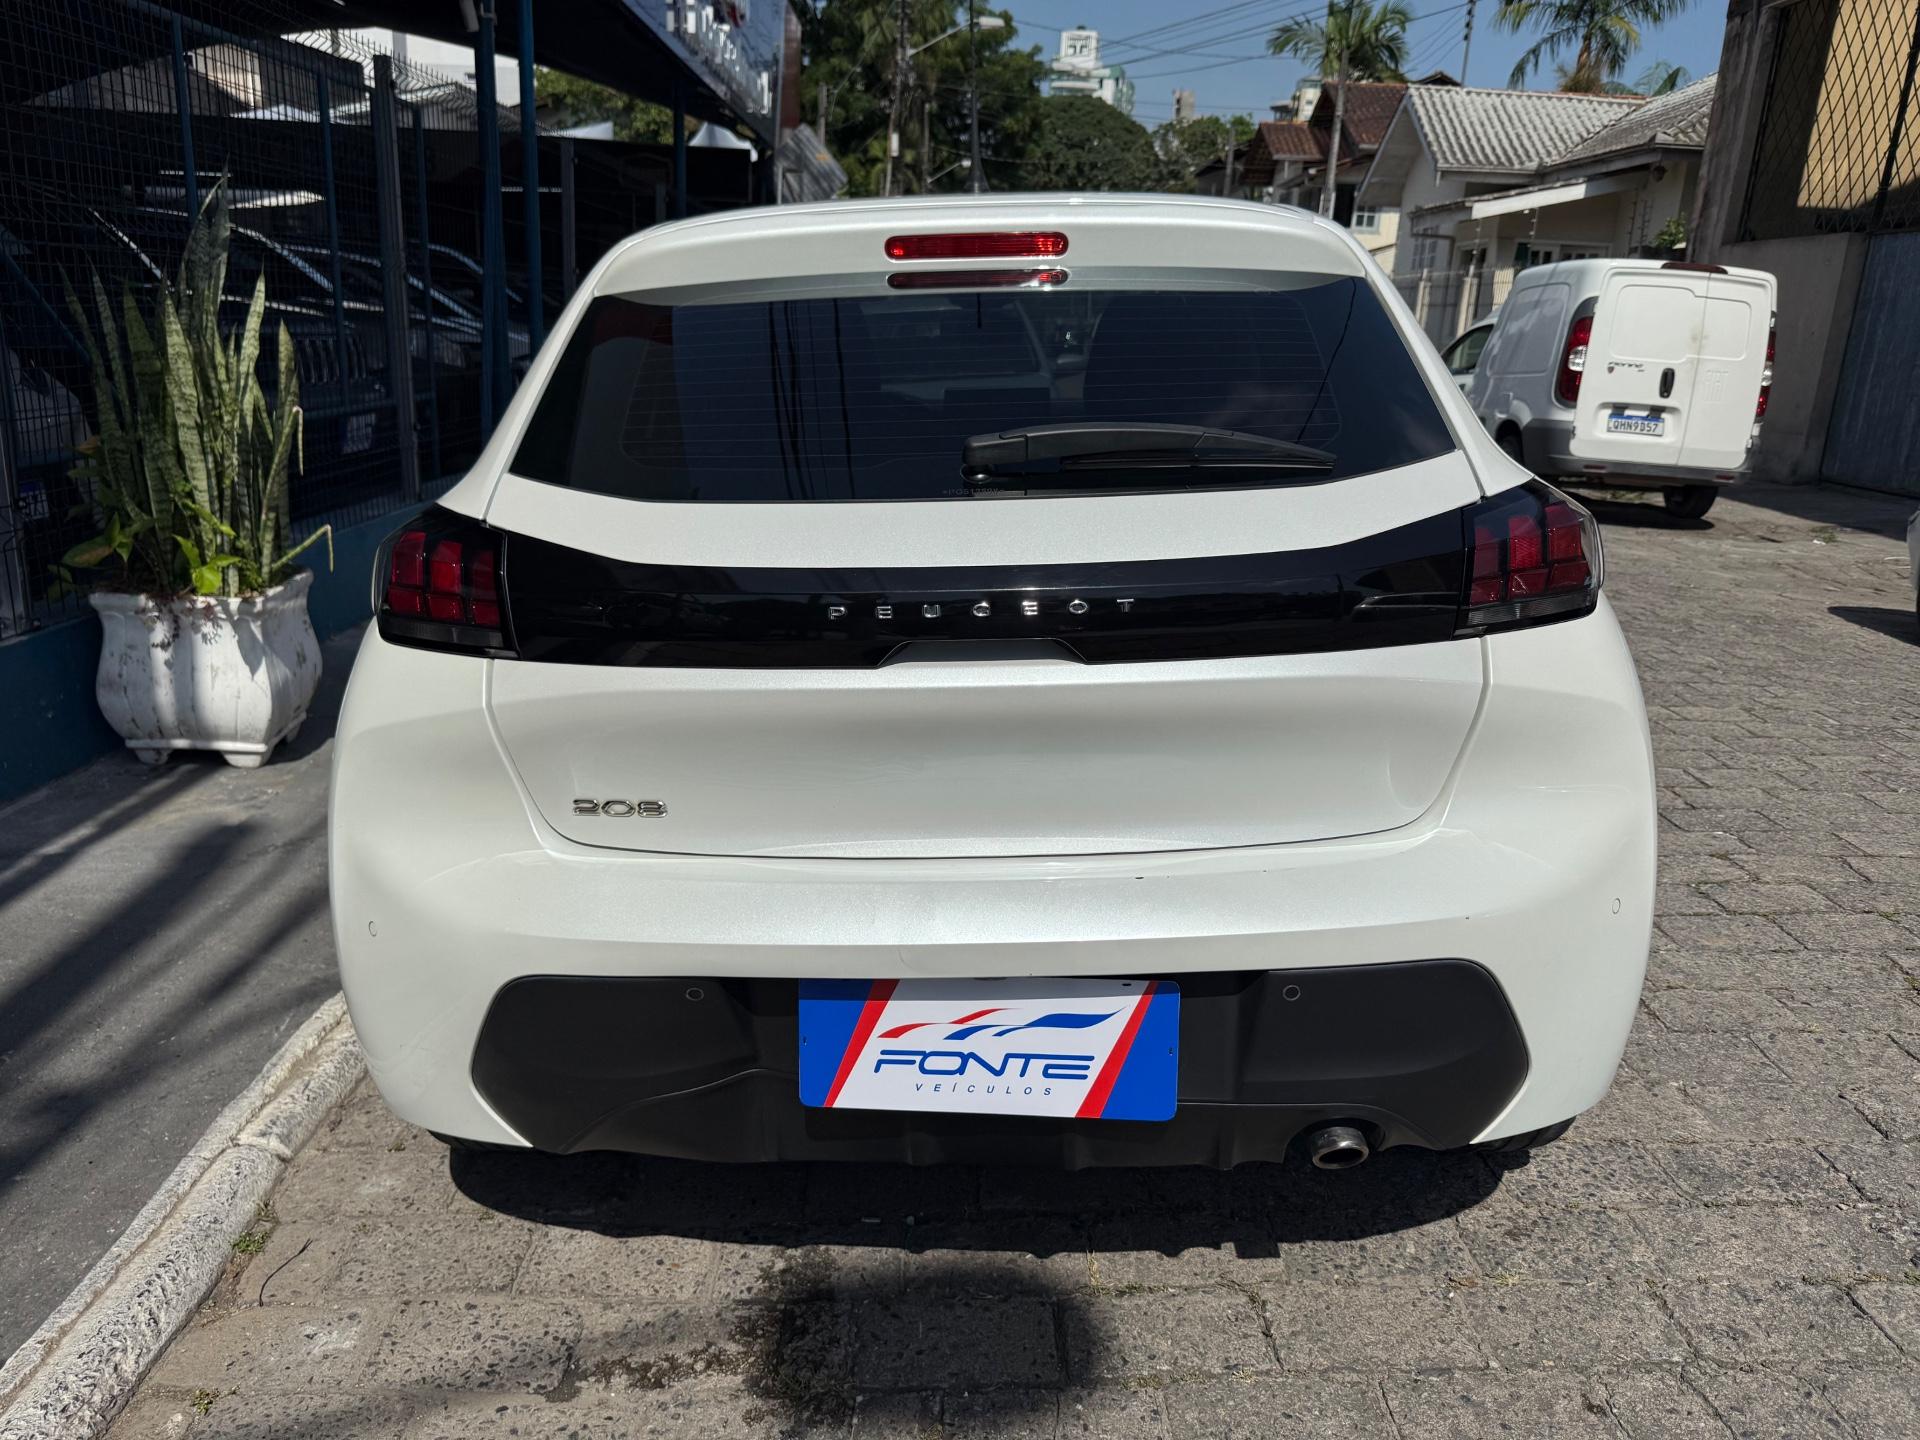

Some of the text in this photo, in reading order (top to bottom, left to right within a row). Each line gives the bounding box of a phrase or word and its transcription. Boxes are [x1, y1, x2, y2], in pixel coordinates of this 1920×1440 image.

[828, 597, 1135, 621] PEUGEOT
[572, 799, 669, 819] 208
[873, 1049, 1096, 1081] FONTE
[915, 1082, 1052, 1096] VEÍCULOS
